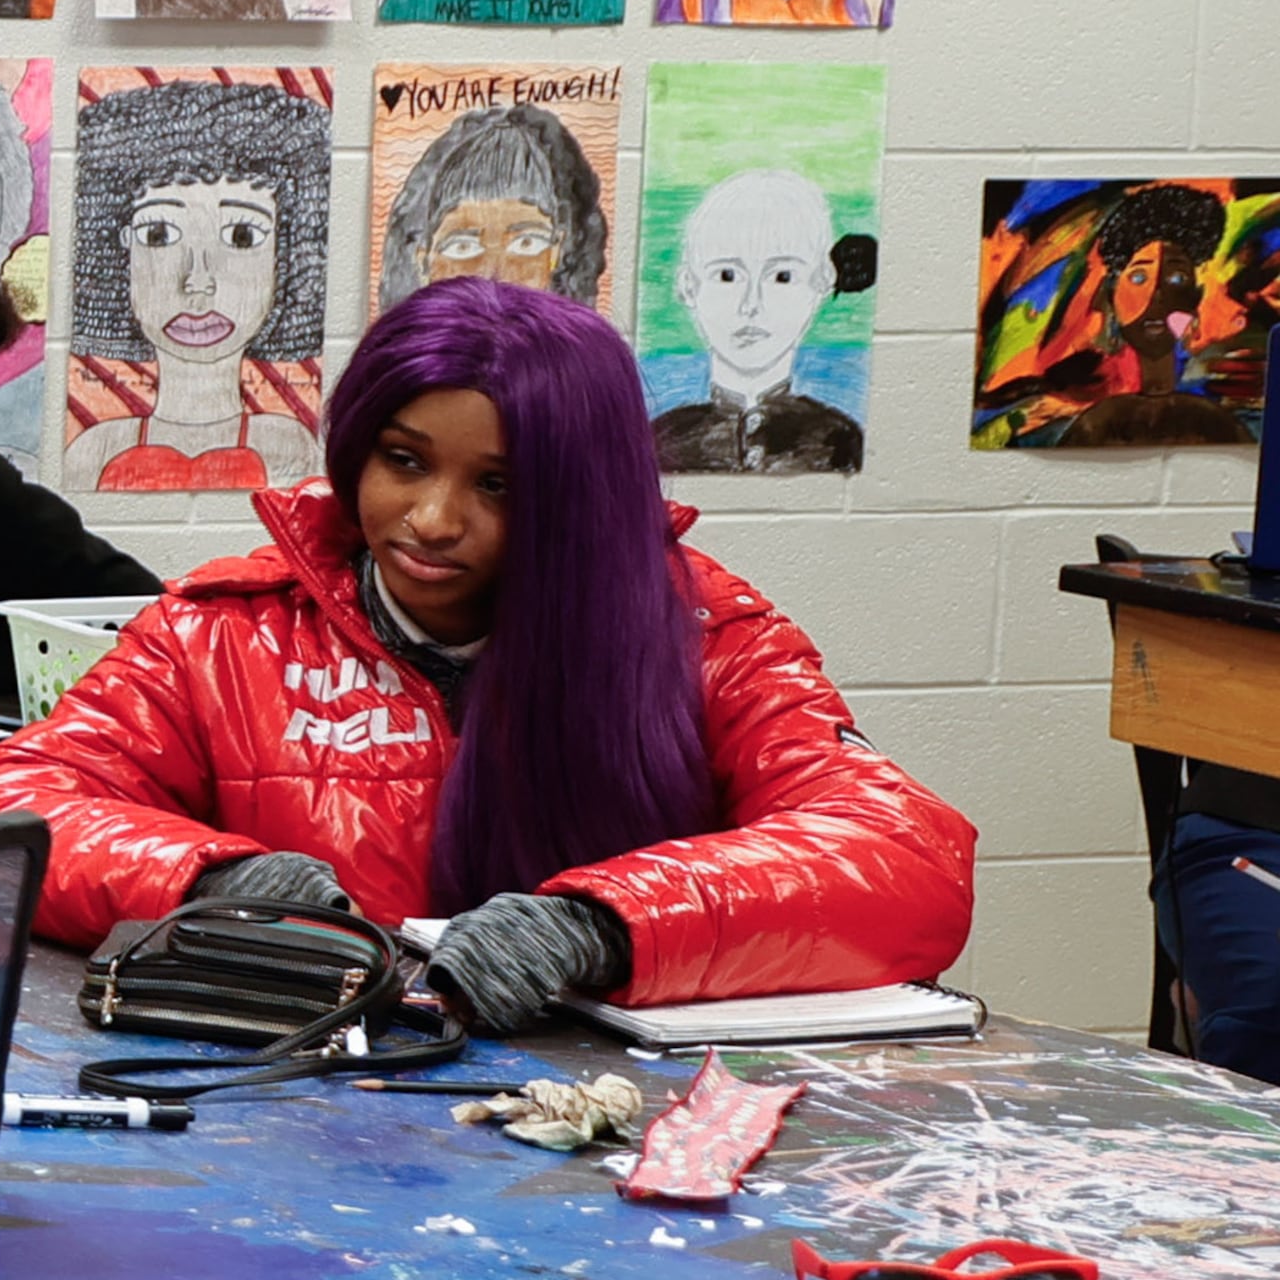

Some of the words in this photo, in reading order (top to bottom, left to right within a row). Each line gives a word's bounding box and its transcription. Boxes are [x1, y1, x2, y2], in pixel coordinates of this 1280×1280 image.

[400, 77, 448, 118] YOU
[453, 76, 503, 109] ARE
[514, 66, 622, 103] ENOUGH!
